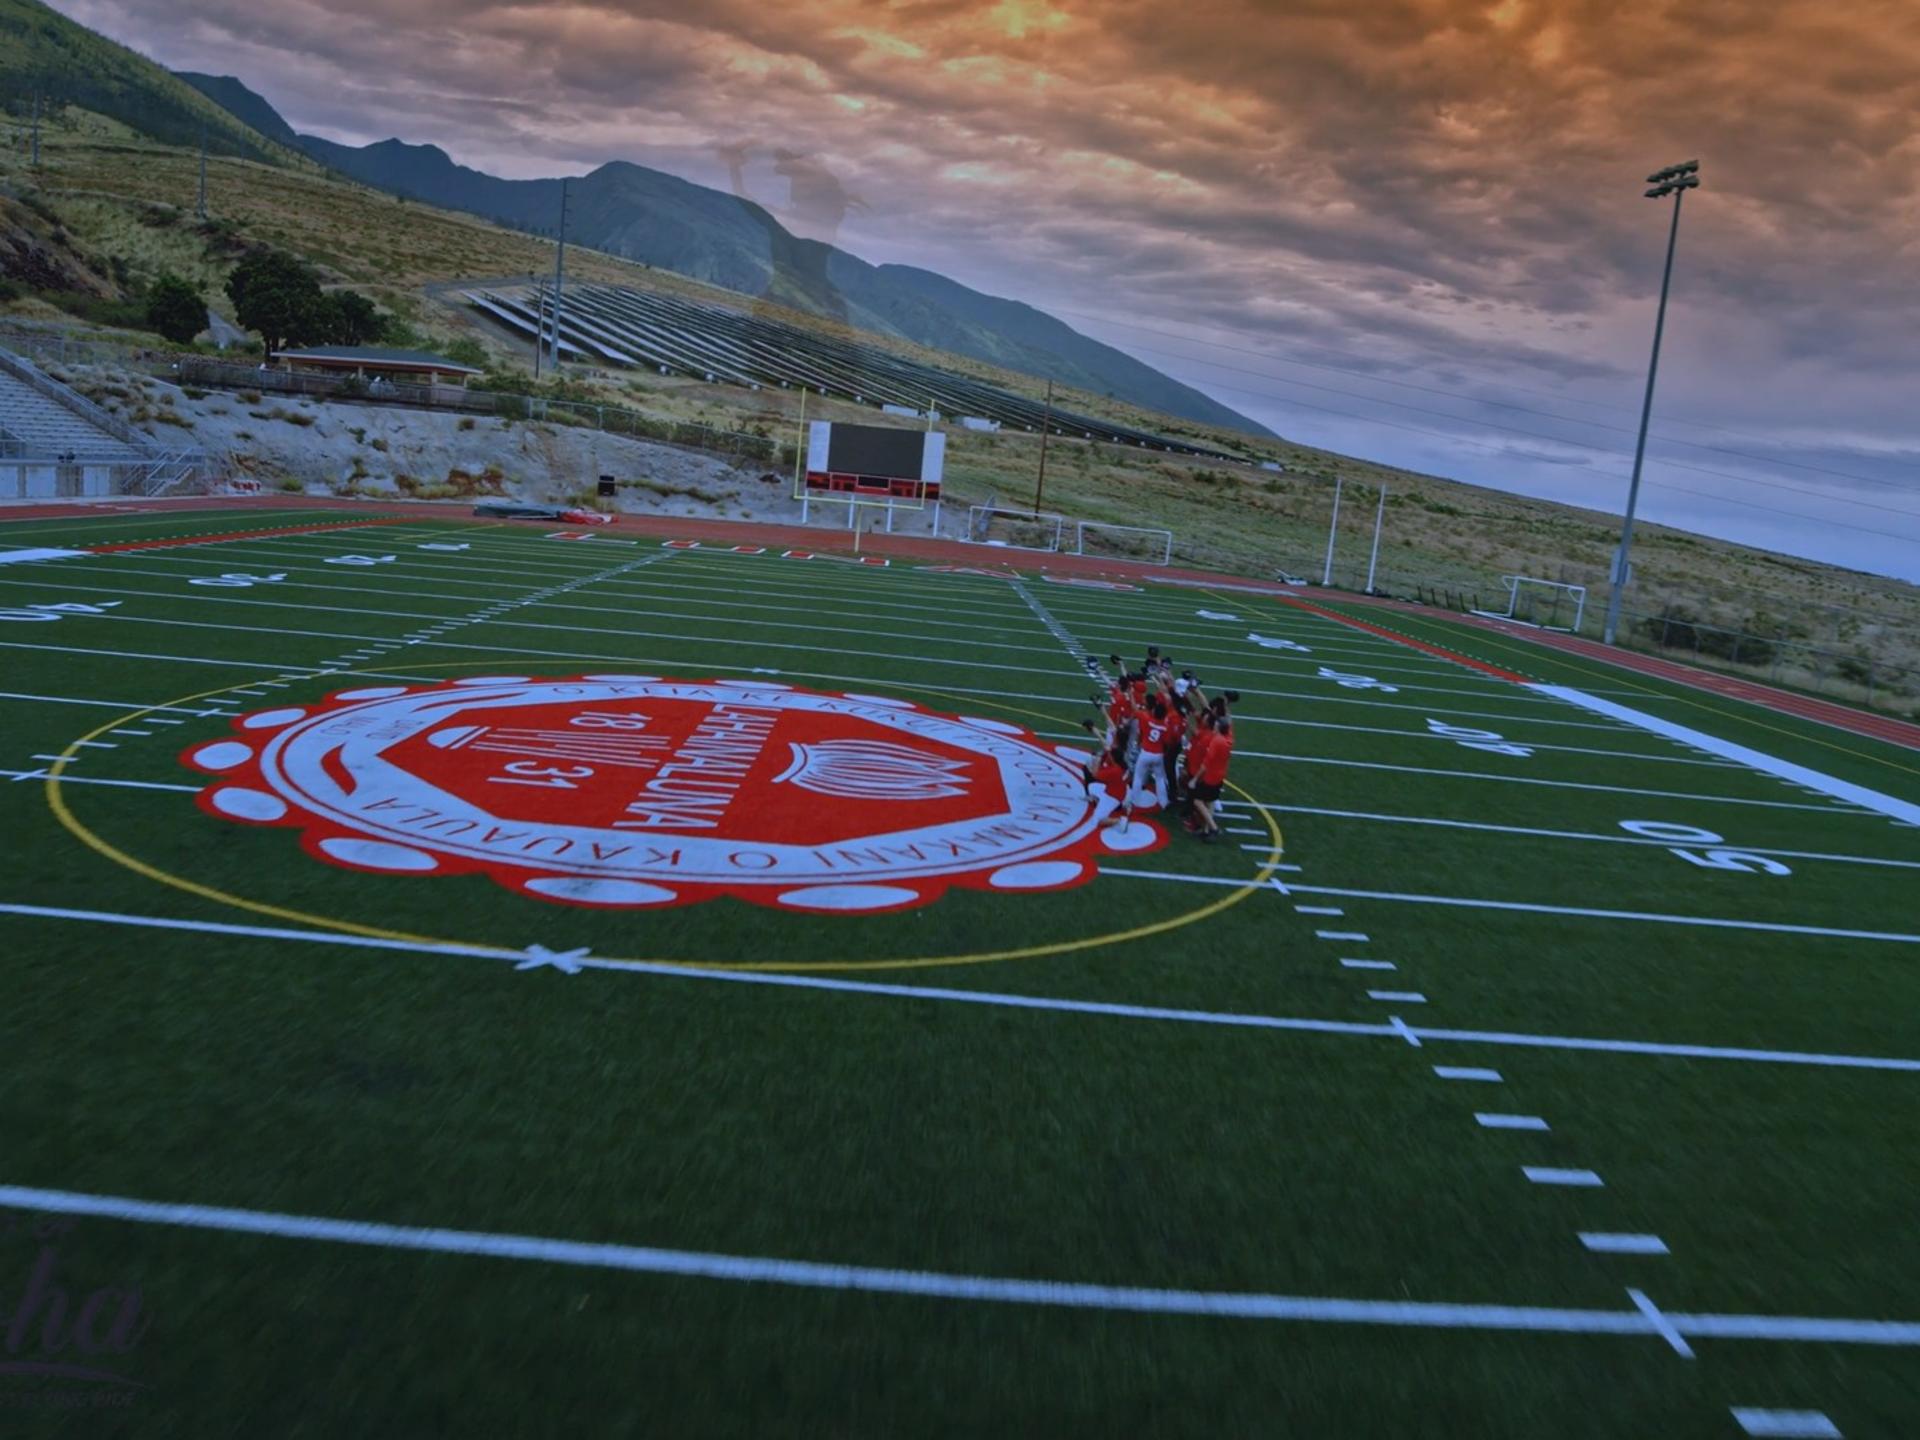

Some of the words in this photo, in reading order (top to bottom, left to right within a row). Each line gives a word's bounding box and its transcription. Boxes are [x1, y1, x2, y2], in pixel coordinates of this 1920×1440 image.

[569, 710, 654, 730] 18
[486, 760, 595, 788] 31
[612, 702, 784, 829] LAHAINALUNA
[363, 797, 682, 866] KAUAULA
[813, 823, 1041, 868] MAKANI
[1618, 820, 1793, 876] 50
[729, 851, 778, 870] O
